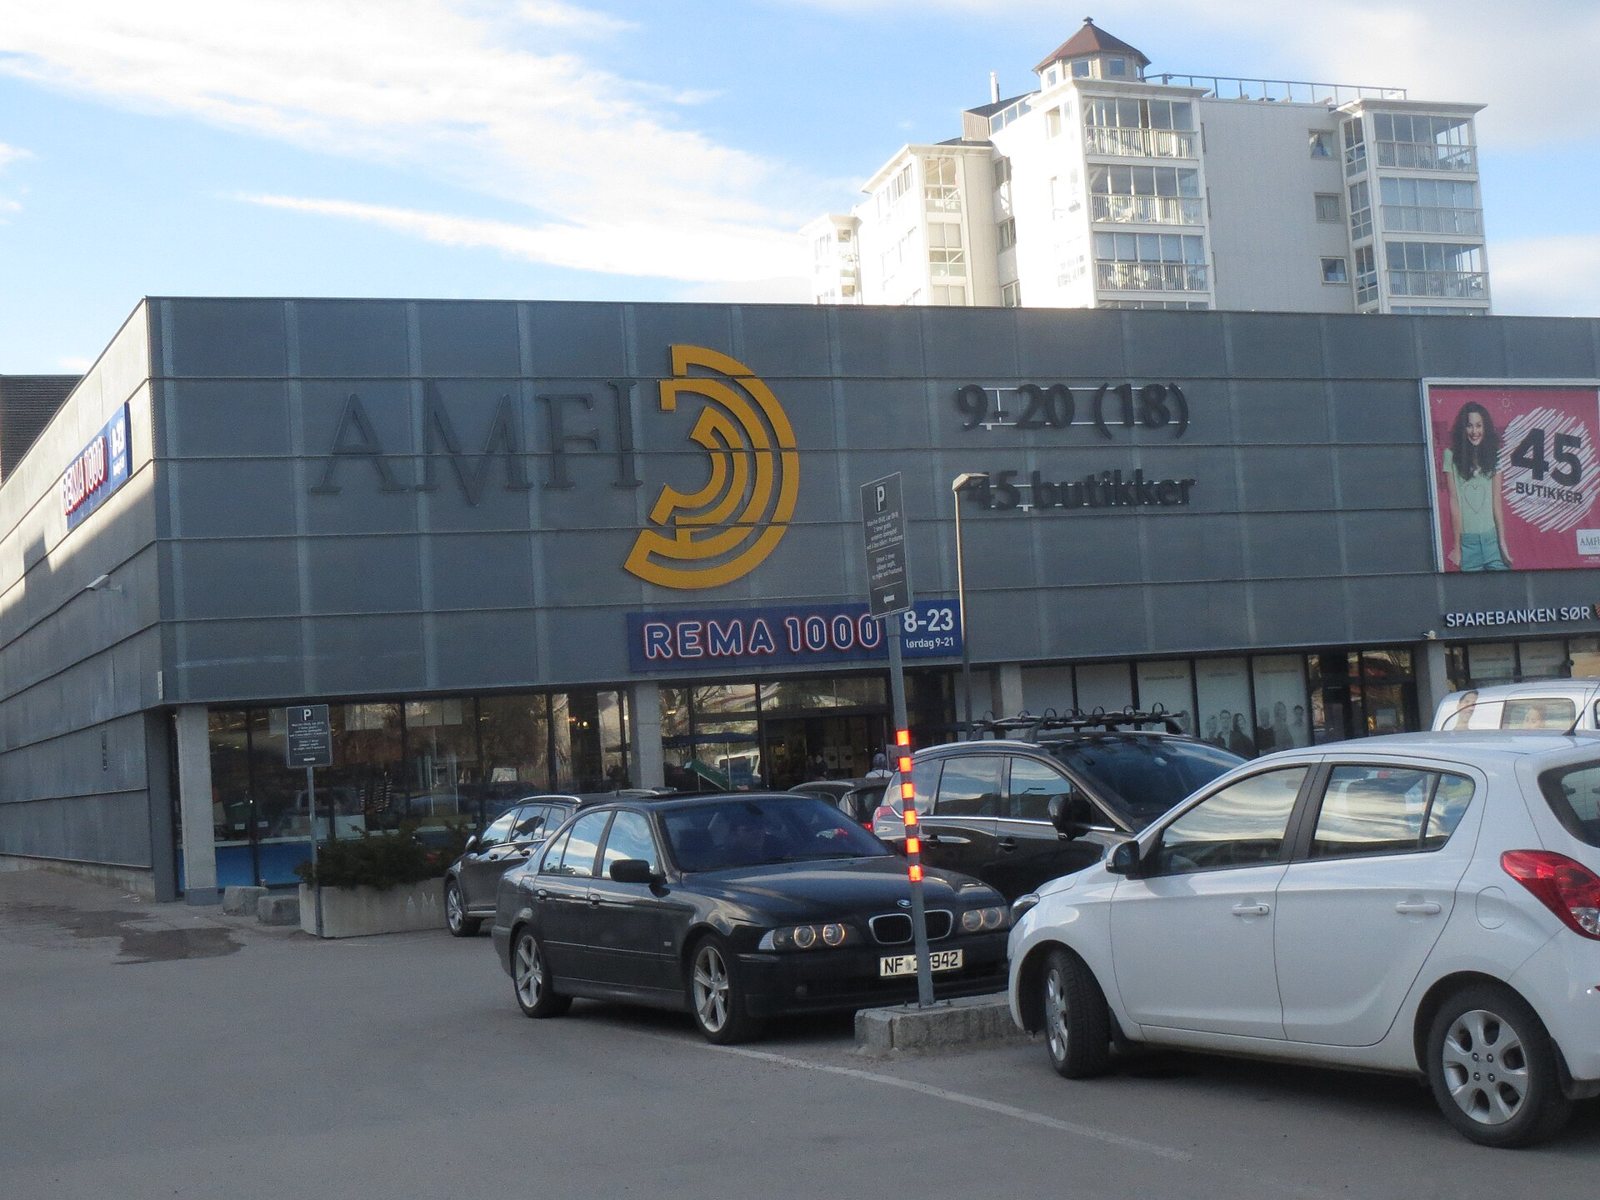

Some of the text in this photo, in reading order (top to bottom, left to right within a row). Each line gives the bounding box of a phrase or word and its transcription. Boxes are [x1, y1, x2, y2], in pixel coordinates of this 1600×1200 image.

[1093, 382, 1189, 439] (18)
[309, 378, 643, 506] AMFI
[1510, 428, 1583, 486] 45
[876, 486, 885, 511] P
[1031, 469, 1197, 509] butikker
[1515, 481, 1583, 504] BUTIKKER
[902, 607, 955, 633] 8-23
[1446, 606, 1591, 627] SPAREBANKEN SØR
[644, 613, 881, 660] REMA 1000
[905, 637, 954, 650] lørdag 9-21
[303, 709, 312, 721] P
[884, 951, 958, 974] NF 942
